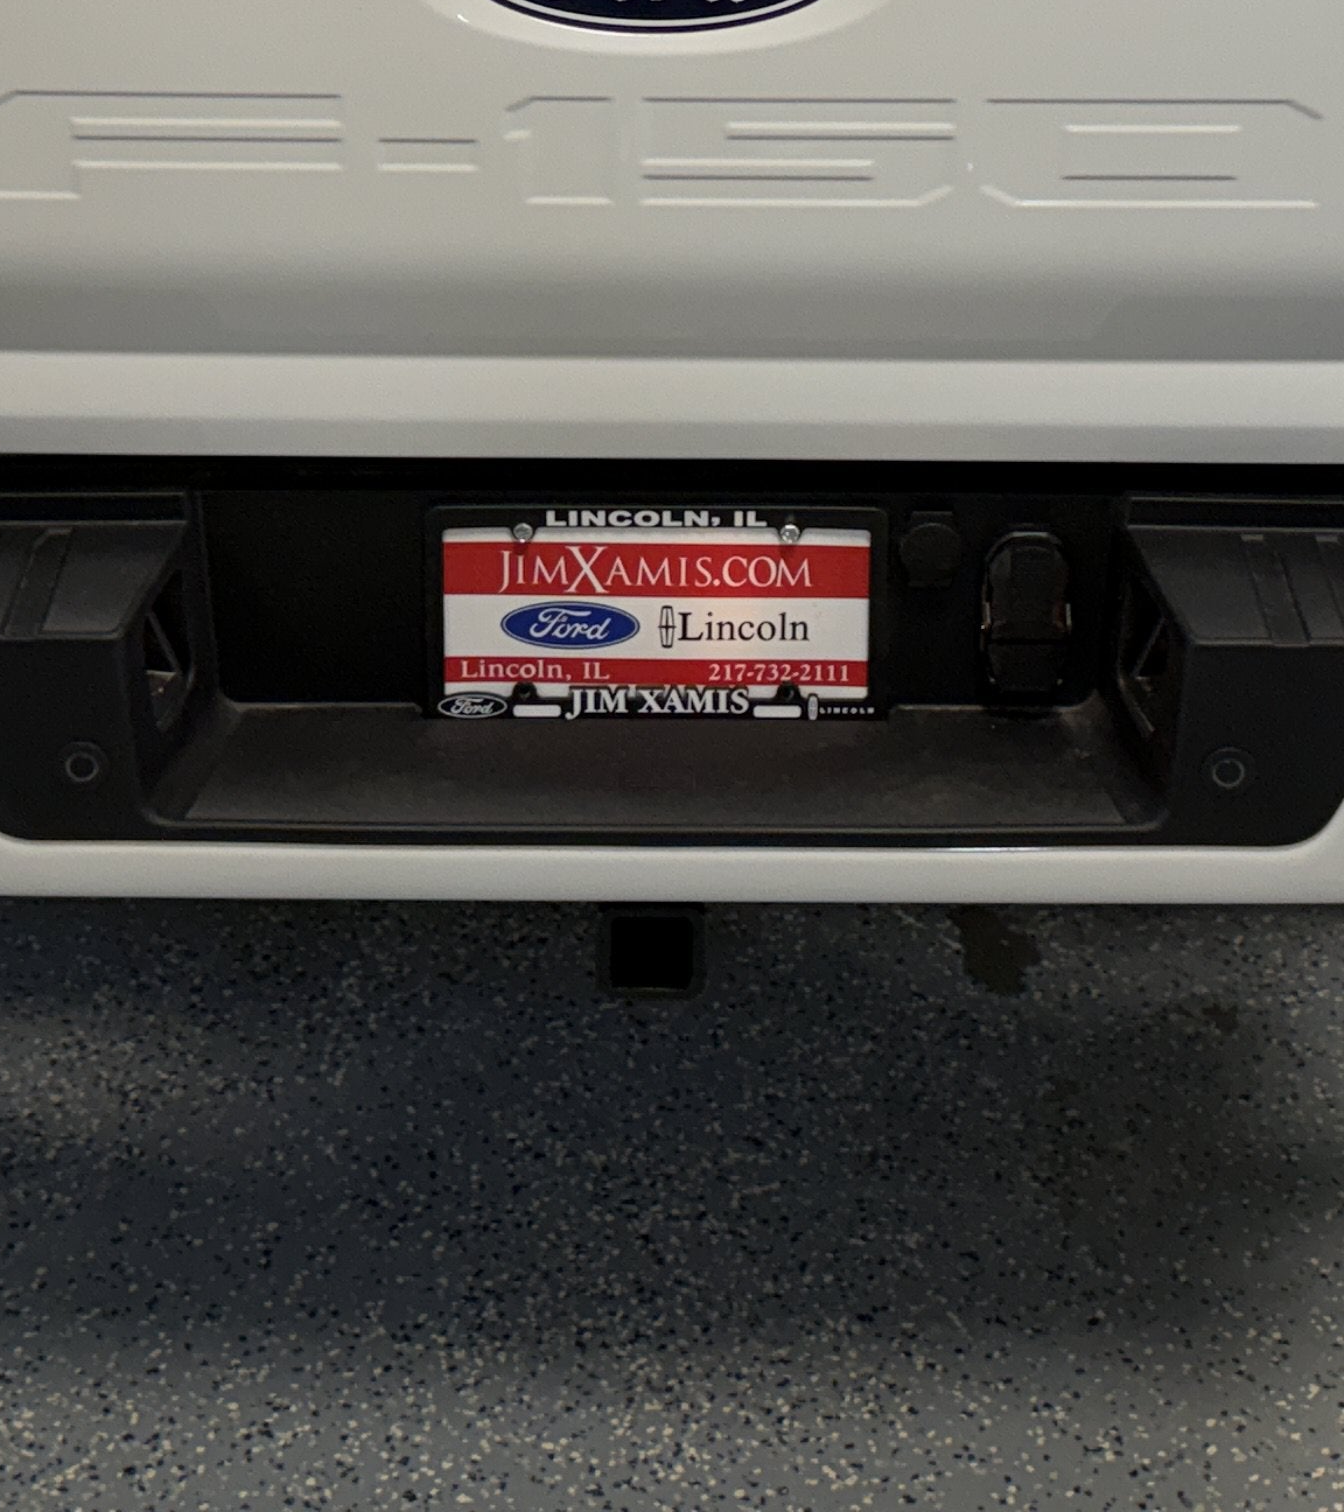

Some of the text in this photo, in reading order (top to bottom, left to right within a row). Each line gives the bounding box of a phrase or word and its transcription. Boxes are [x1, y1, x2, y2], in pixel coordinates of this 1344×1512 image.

[545, 510, 768, 528] LINCOLN, IL
[498, 545, 813, 594] JIMXAMIS.COM
[528, 609, 610, 641] Ford
[677, 612, 809, 642] Lincoln
[460, 659, 610, 681] Lincoln, IL
[708, 663, 850, 683] 217-732-2111
[448, 697, 494, 715] Ford
[565, 688, 750, 719] JIM XAMIS
[819, 706, 875, 715] LINCOLN
